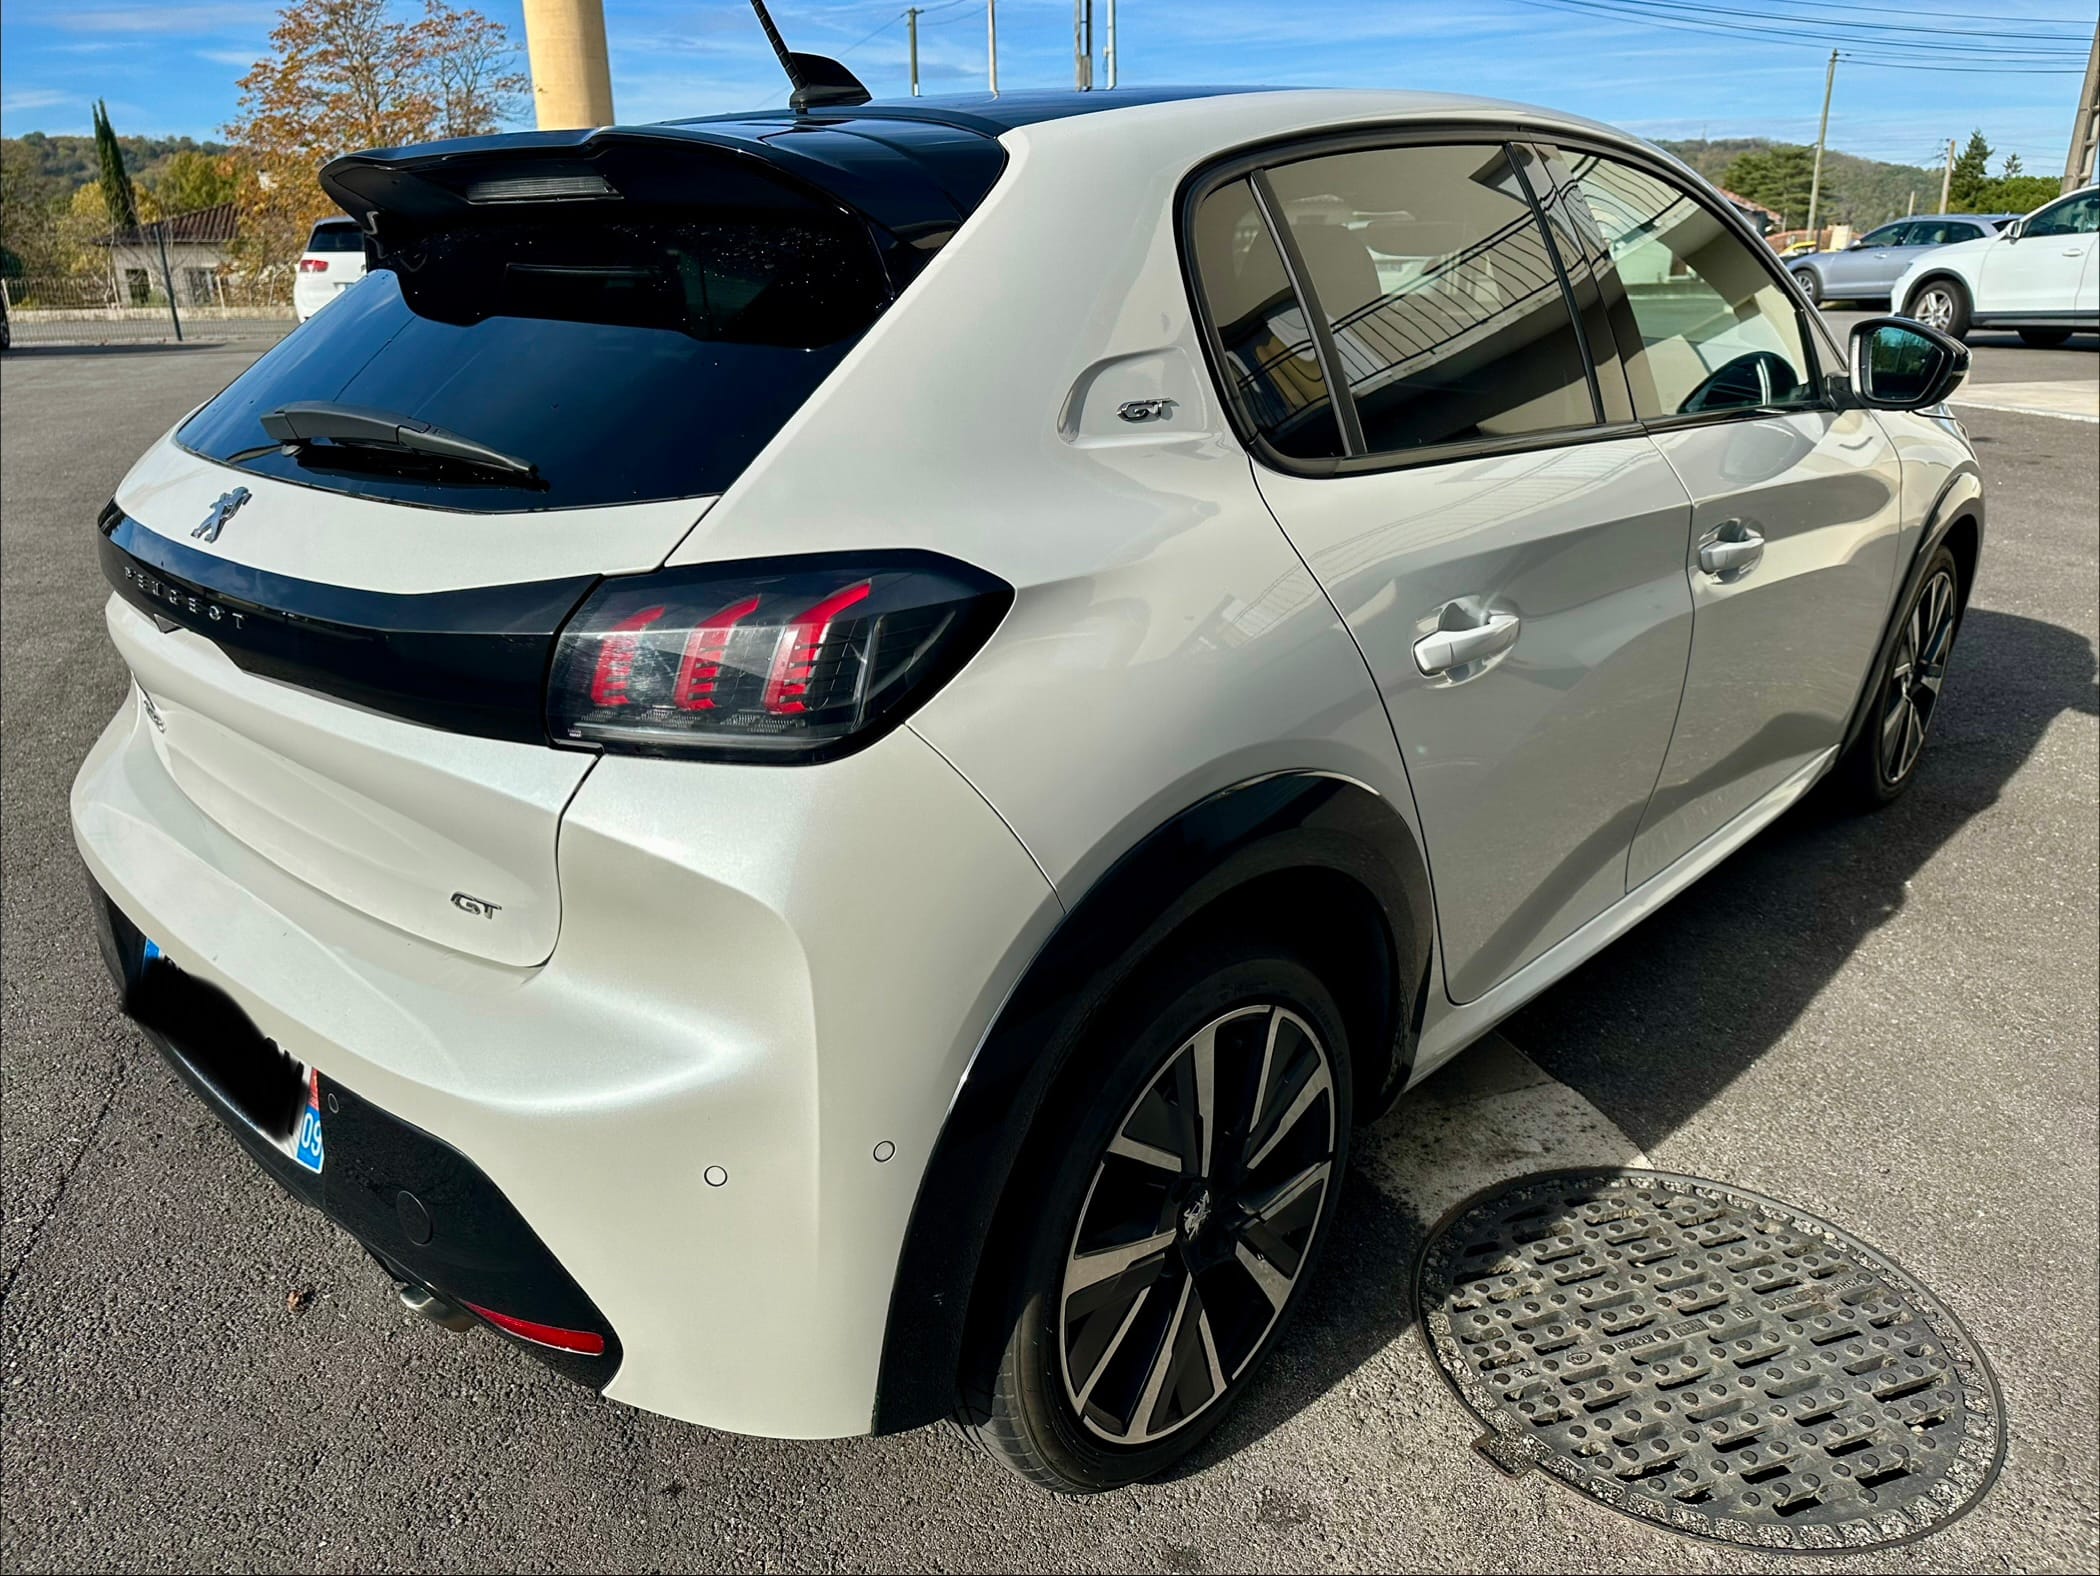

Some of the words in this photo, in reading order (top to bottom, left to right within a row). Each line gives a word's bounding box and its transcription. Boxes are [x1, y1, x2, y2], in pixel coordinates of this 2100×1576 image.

[1116, 397, 1176, 423] GT
[123, 565, 249, 630] PEUGEOT
[450, 890, 502, 920] GT
[301, 1112, 323, 1157] 09
